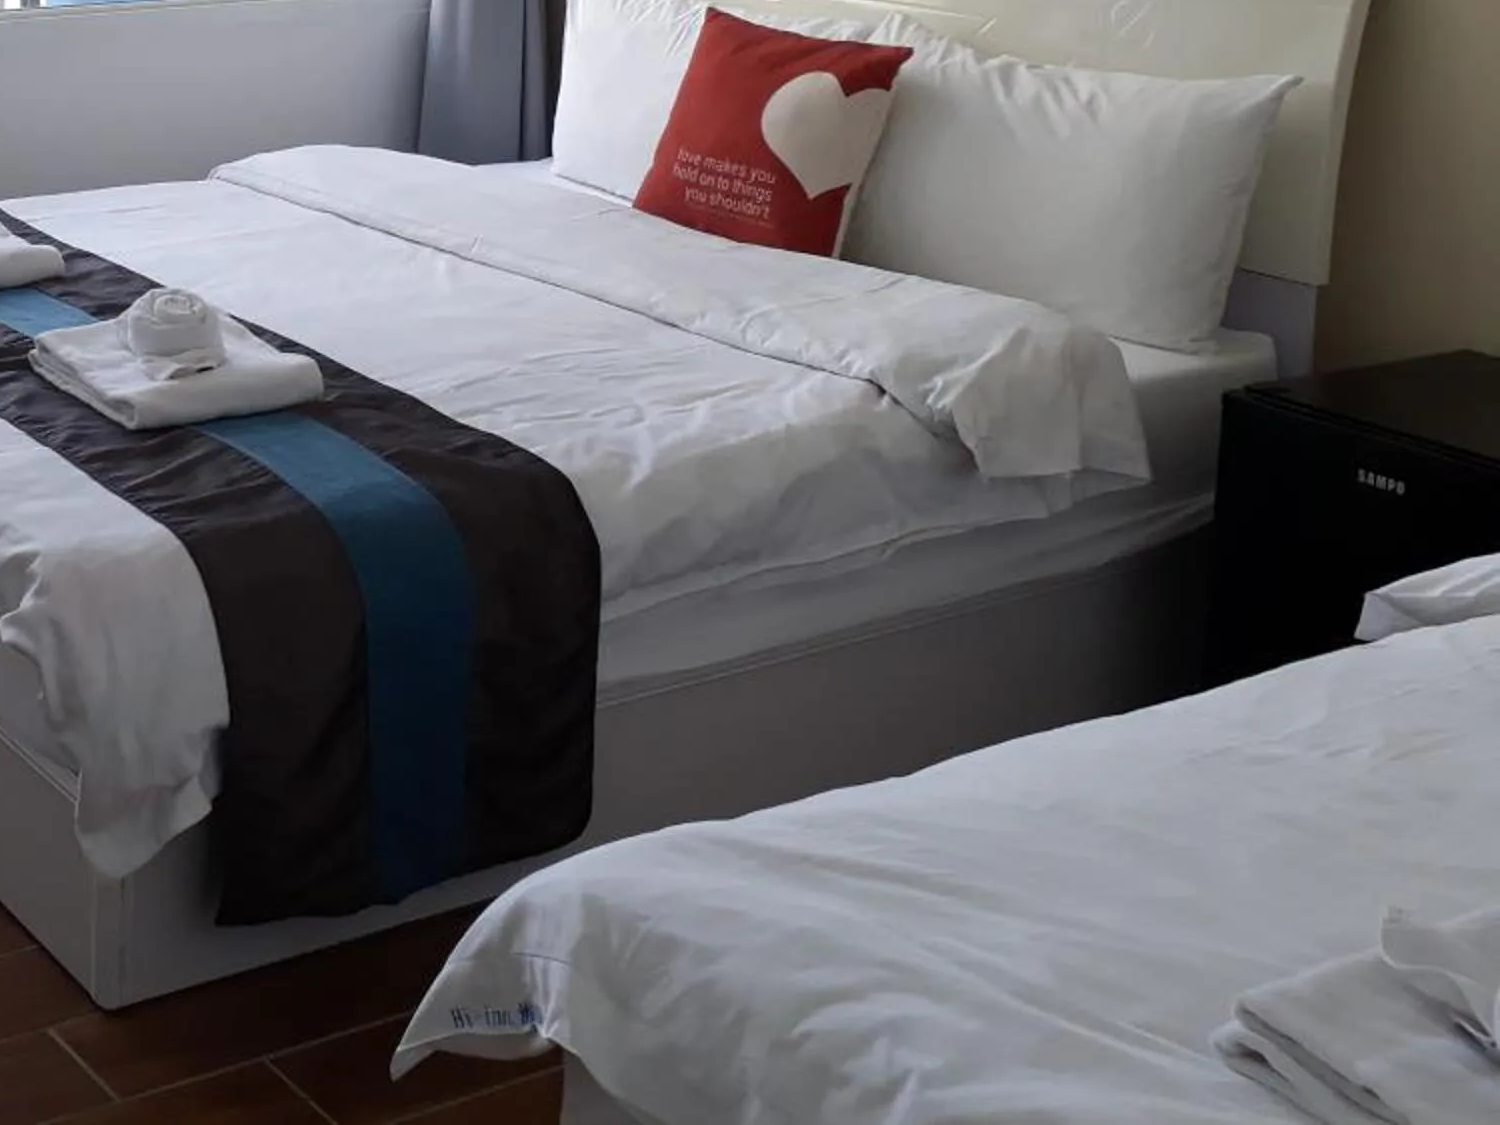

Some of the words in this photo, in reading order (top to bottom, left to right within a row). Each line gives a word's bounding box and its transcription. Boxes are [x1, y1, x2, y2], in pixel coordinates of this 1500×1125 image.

[677, 147, 701, 166] love
[703, 156, 747, 178] makes
[746, 167, 776, 185] you
[685, 186, 707, 203] you
[709, 192, 770, 219] shouldn't
[699, 173, 715, 187] on
[717, 174, 730, 191] to
[732, 177, 773, 204] things
